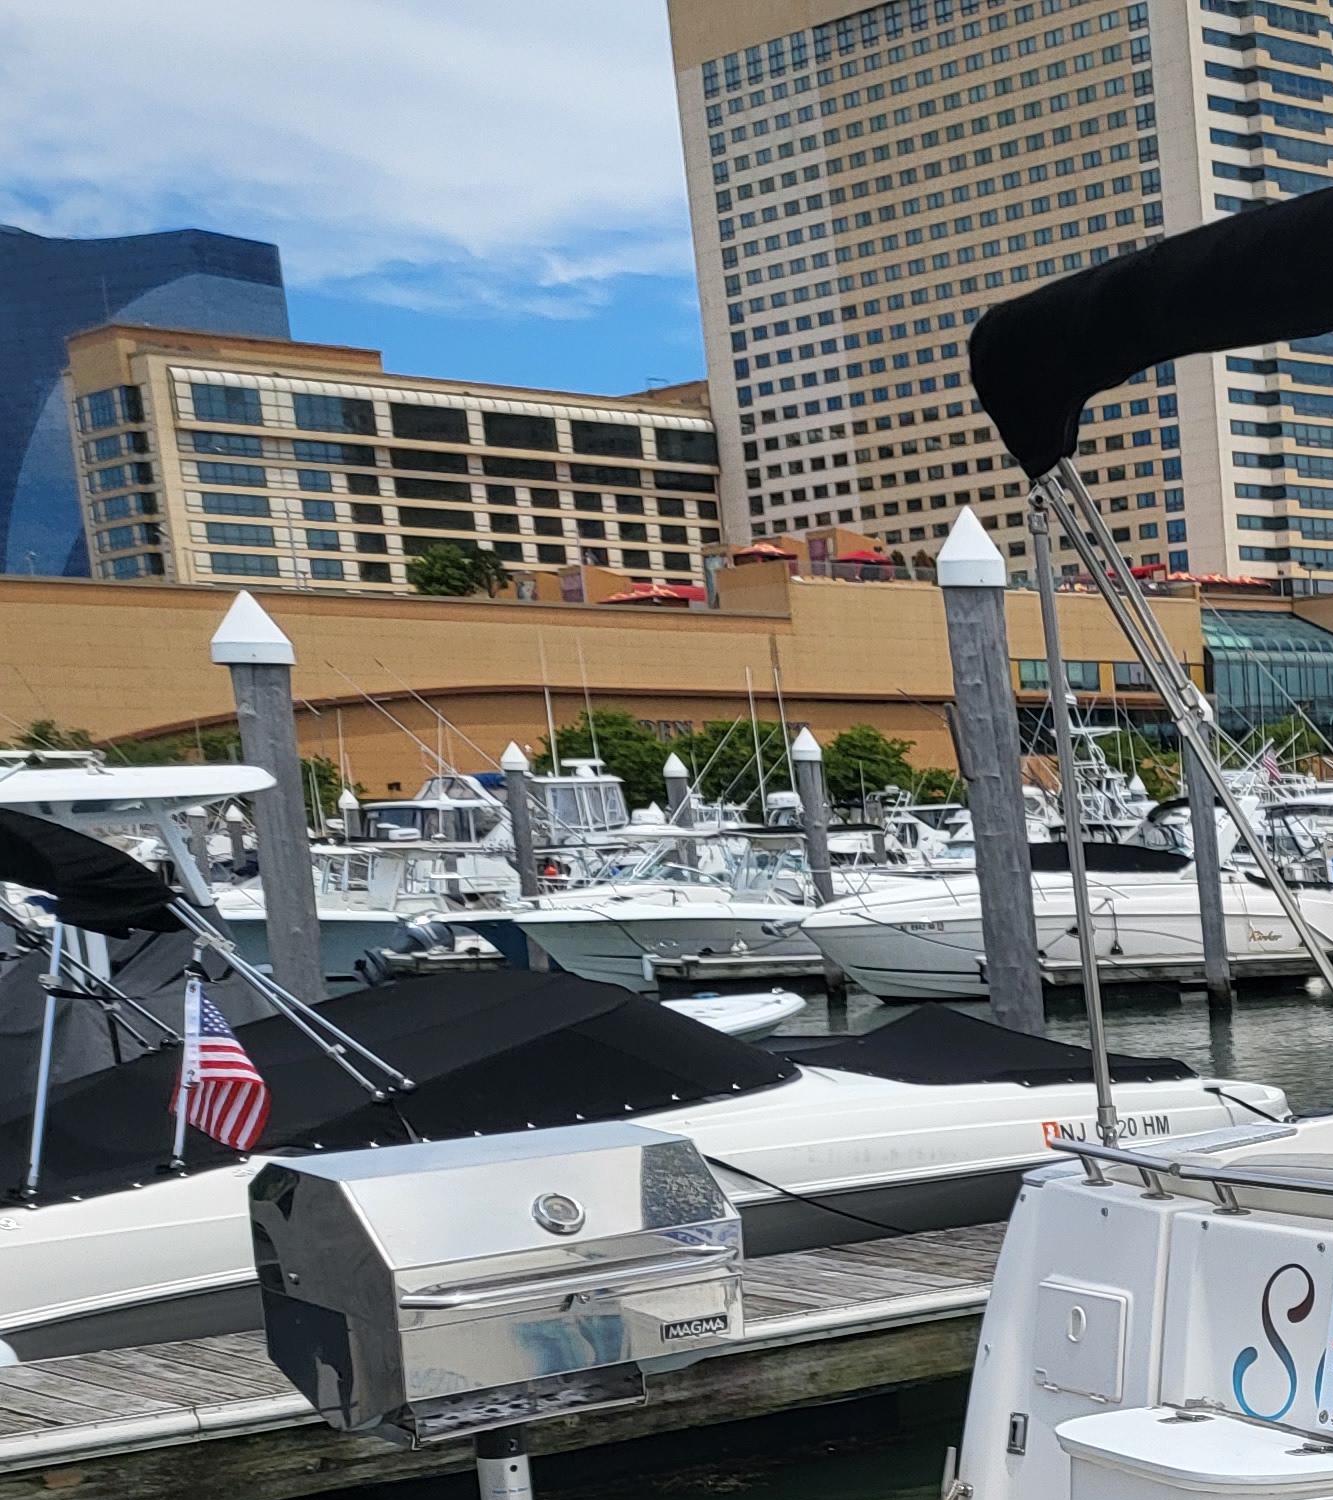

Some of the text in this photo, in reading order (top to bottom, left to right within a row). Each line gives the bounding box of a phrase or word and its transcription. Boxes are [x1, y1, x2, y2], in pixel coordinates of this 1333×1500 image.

[1060, 1115, 1170, 1142] NJ 020 HM
[668, 1318, 724, 1339] MAGMA
